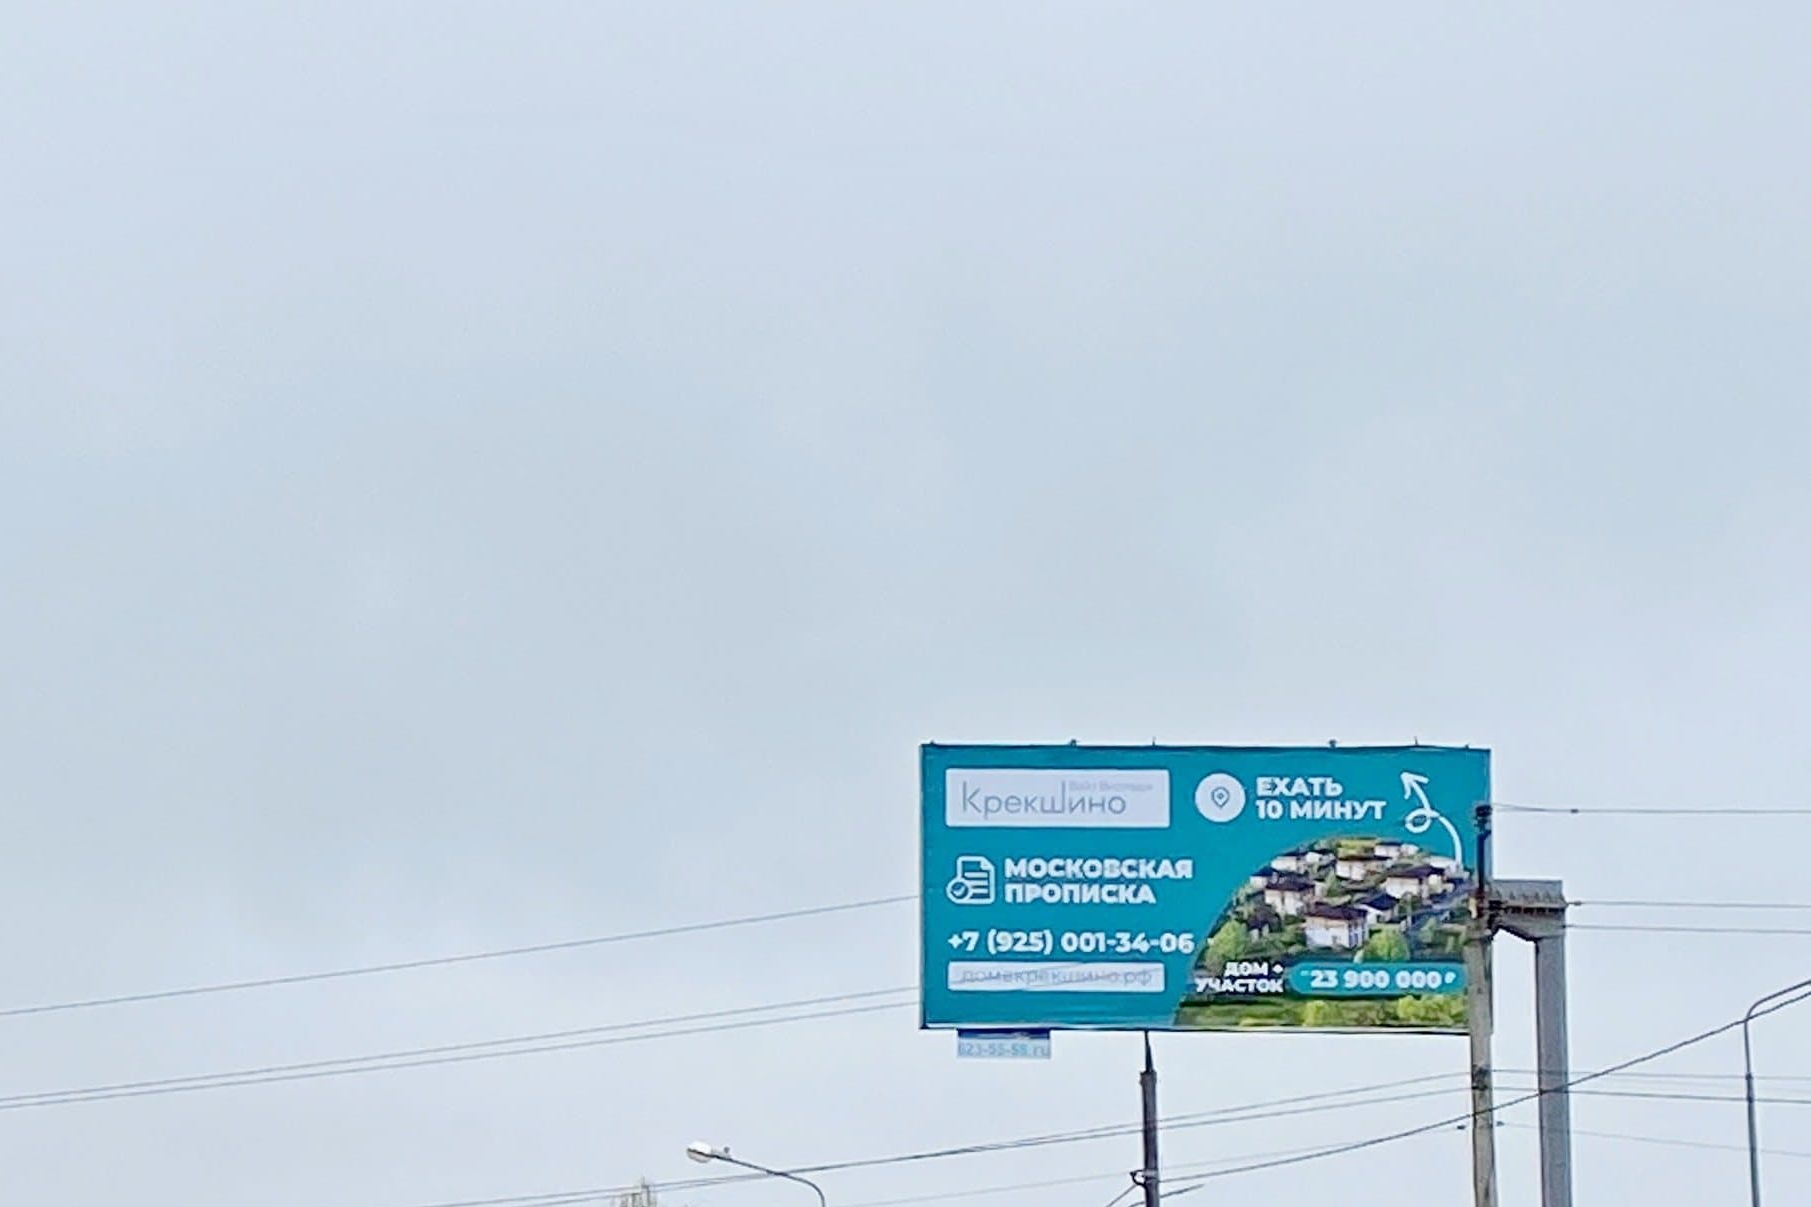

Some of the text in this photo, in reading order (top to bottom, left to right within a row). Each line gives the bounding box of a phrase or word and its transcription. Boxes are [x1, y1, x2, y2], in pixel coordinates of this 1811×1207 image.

[1255, 776, 1343, 797] ЕХАТЬ
[962, 780, 1126, 819] Крекшино
[1256, 800, 1387, 820] 10 МИНУТ
[1005, 858, 1193, 880] МОСКОВСКАЯ
[1005, 882, 1156, 904] ПРОПИСКА
[947, 929, 1195, 955] +7 (925) 001-34-06
[1223, 961, 1268, 977] ДОМ
[1310, 969, 1339, 988] 23
[1343, 969, 1390, 989] 900
[1194, 977, 1284, 994] УЧАСТОК
